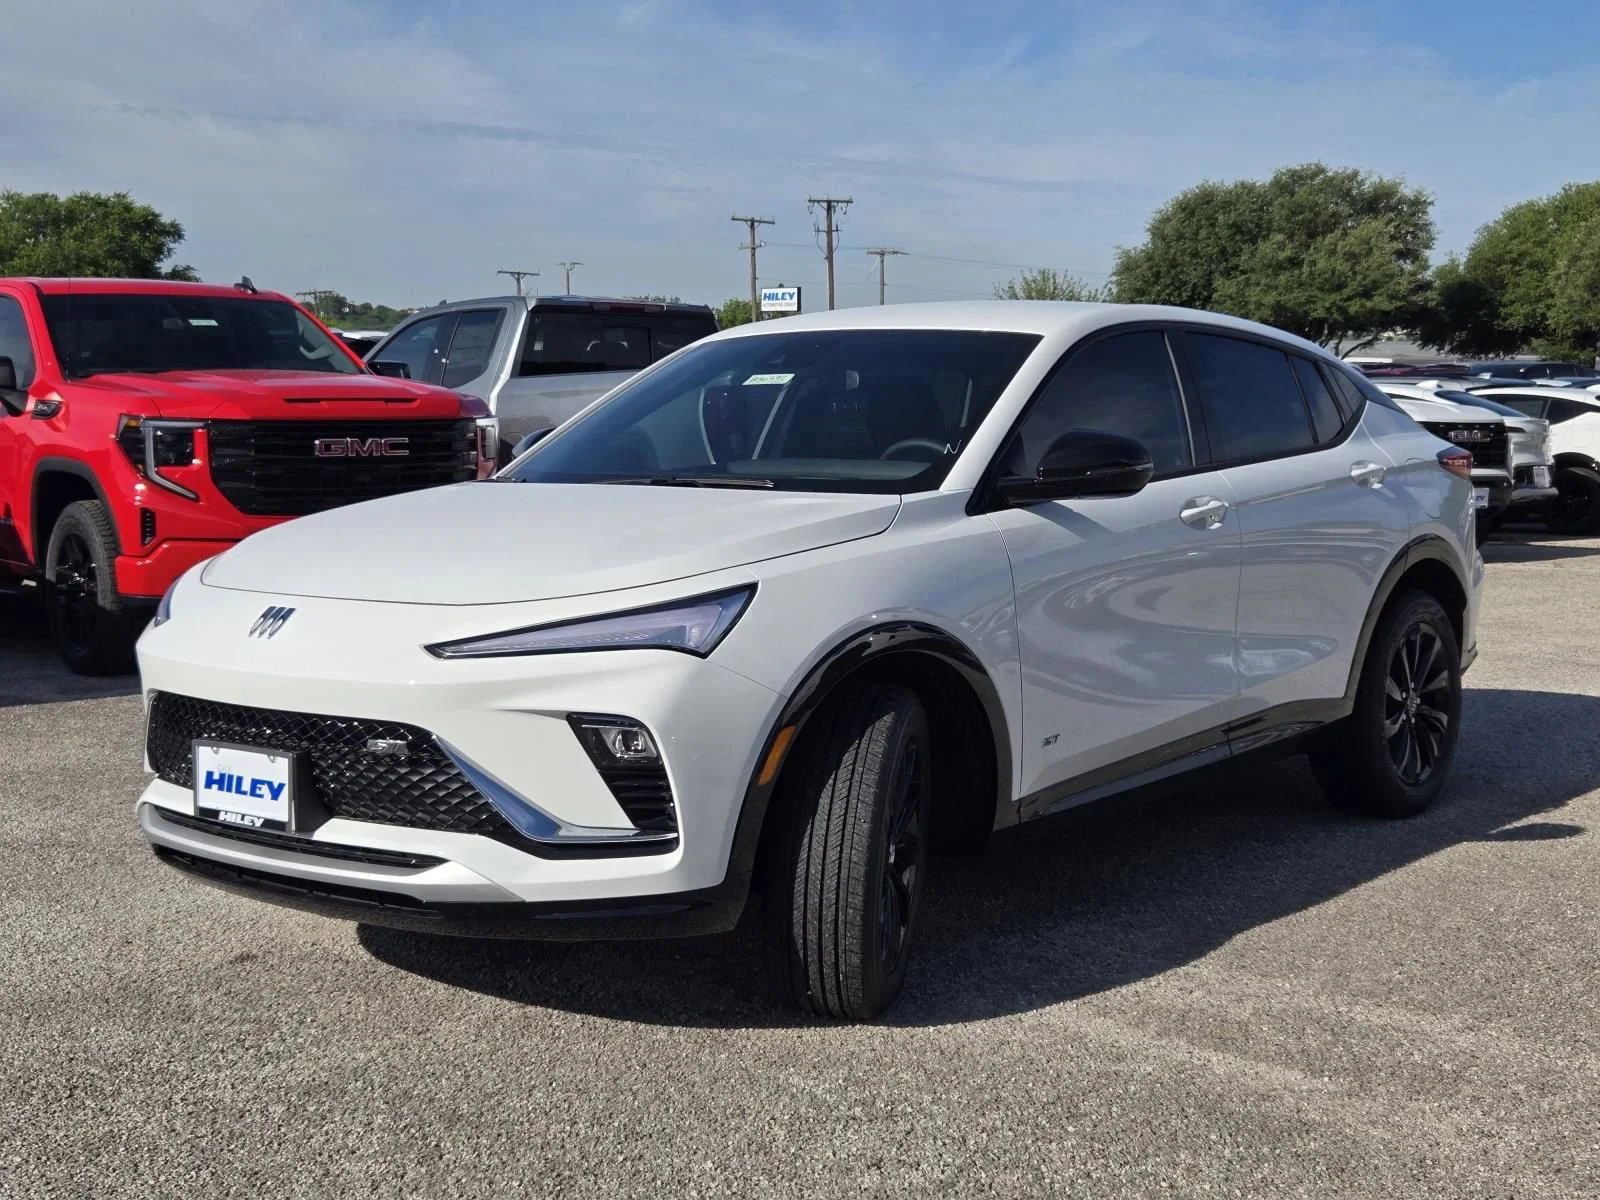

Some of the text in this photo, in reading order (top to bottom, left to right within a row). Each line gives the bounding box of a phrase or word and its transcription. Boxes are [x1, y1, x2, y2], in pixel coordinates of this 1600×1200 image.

[763, 291, 796, 301] HILEY
[314, 437, 410, 457] GMC
[204, 770, 287, 801] HILEY
[218, 810, 265, 828] HILEY
